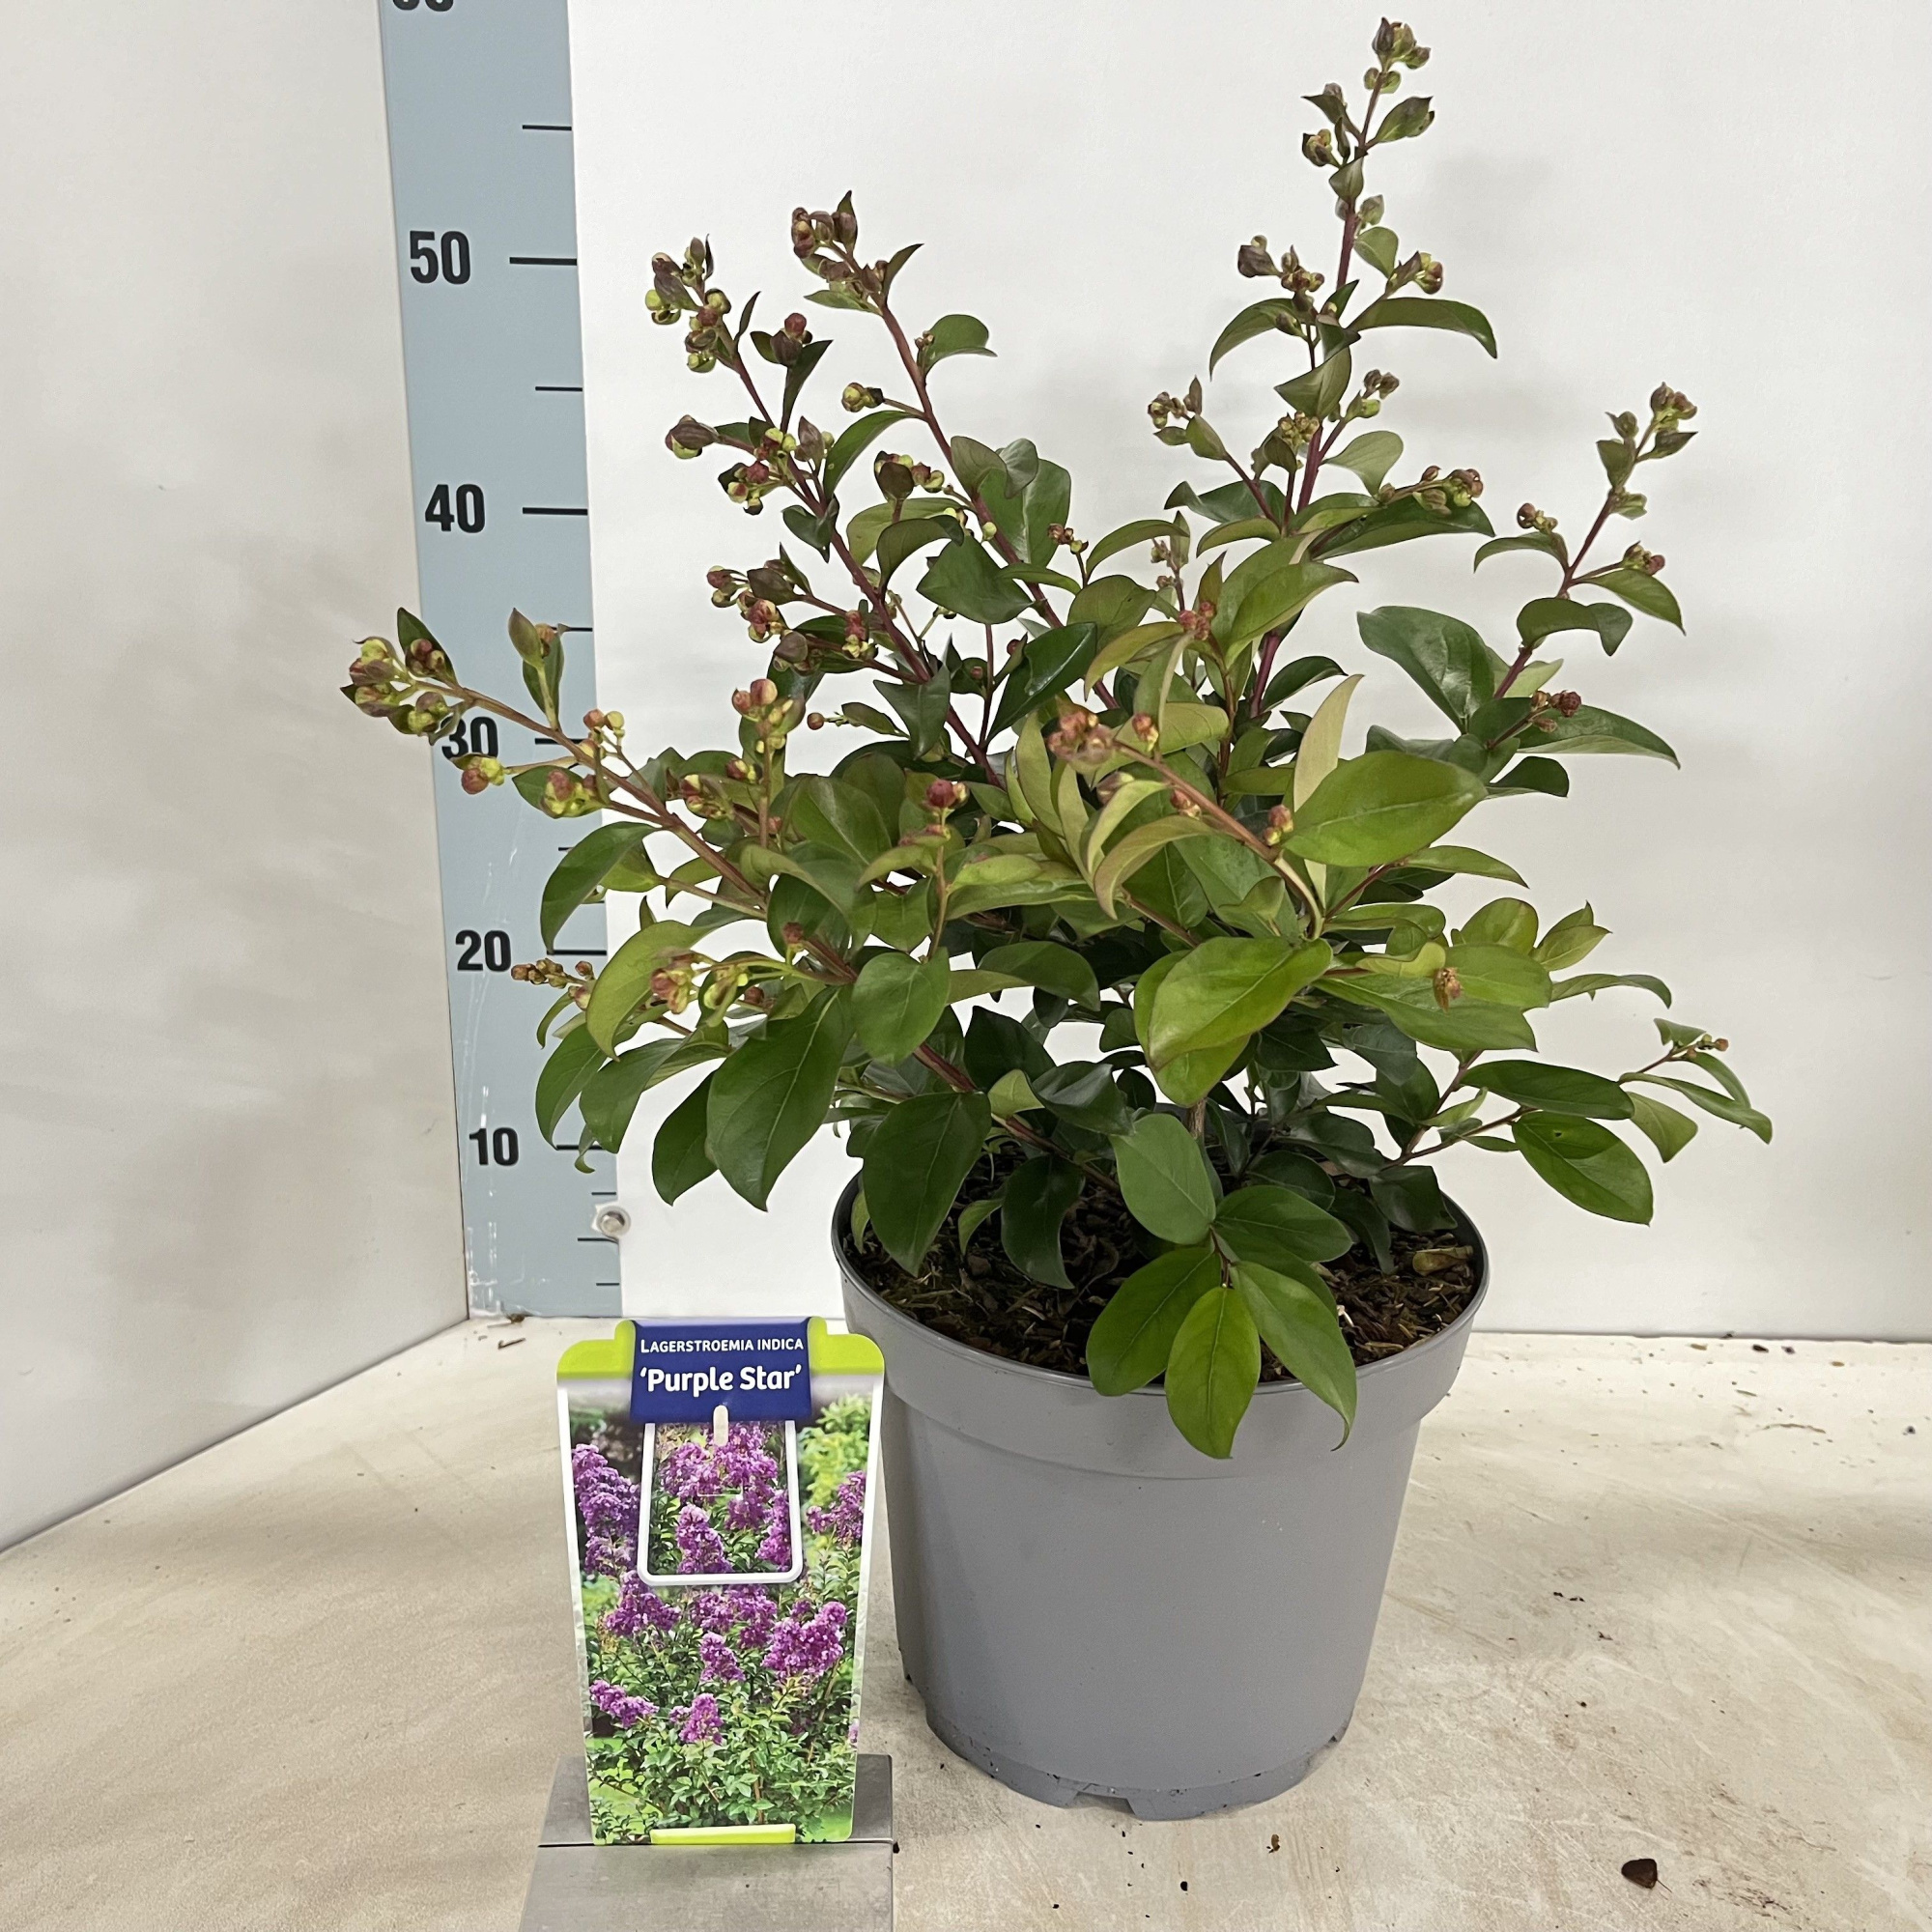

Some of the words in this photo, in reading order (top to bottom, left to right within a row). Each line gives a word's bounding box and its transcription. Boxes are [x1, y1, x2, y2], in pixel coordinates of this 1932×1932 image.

[410, 230, 470, 285] 50
[425, 483, 486, 533] 40
[440, 716, 498, 760] 30
[455, 929, 511, 973] 20
[469, 1127, 519, 1166] 10
[640, 1339, 754, 1353] LAGERSTROEMIA
[757, 1338, 804, 1351] INDICA
